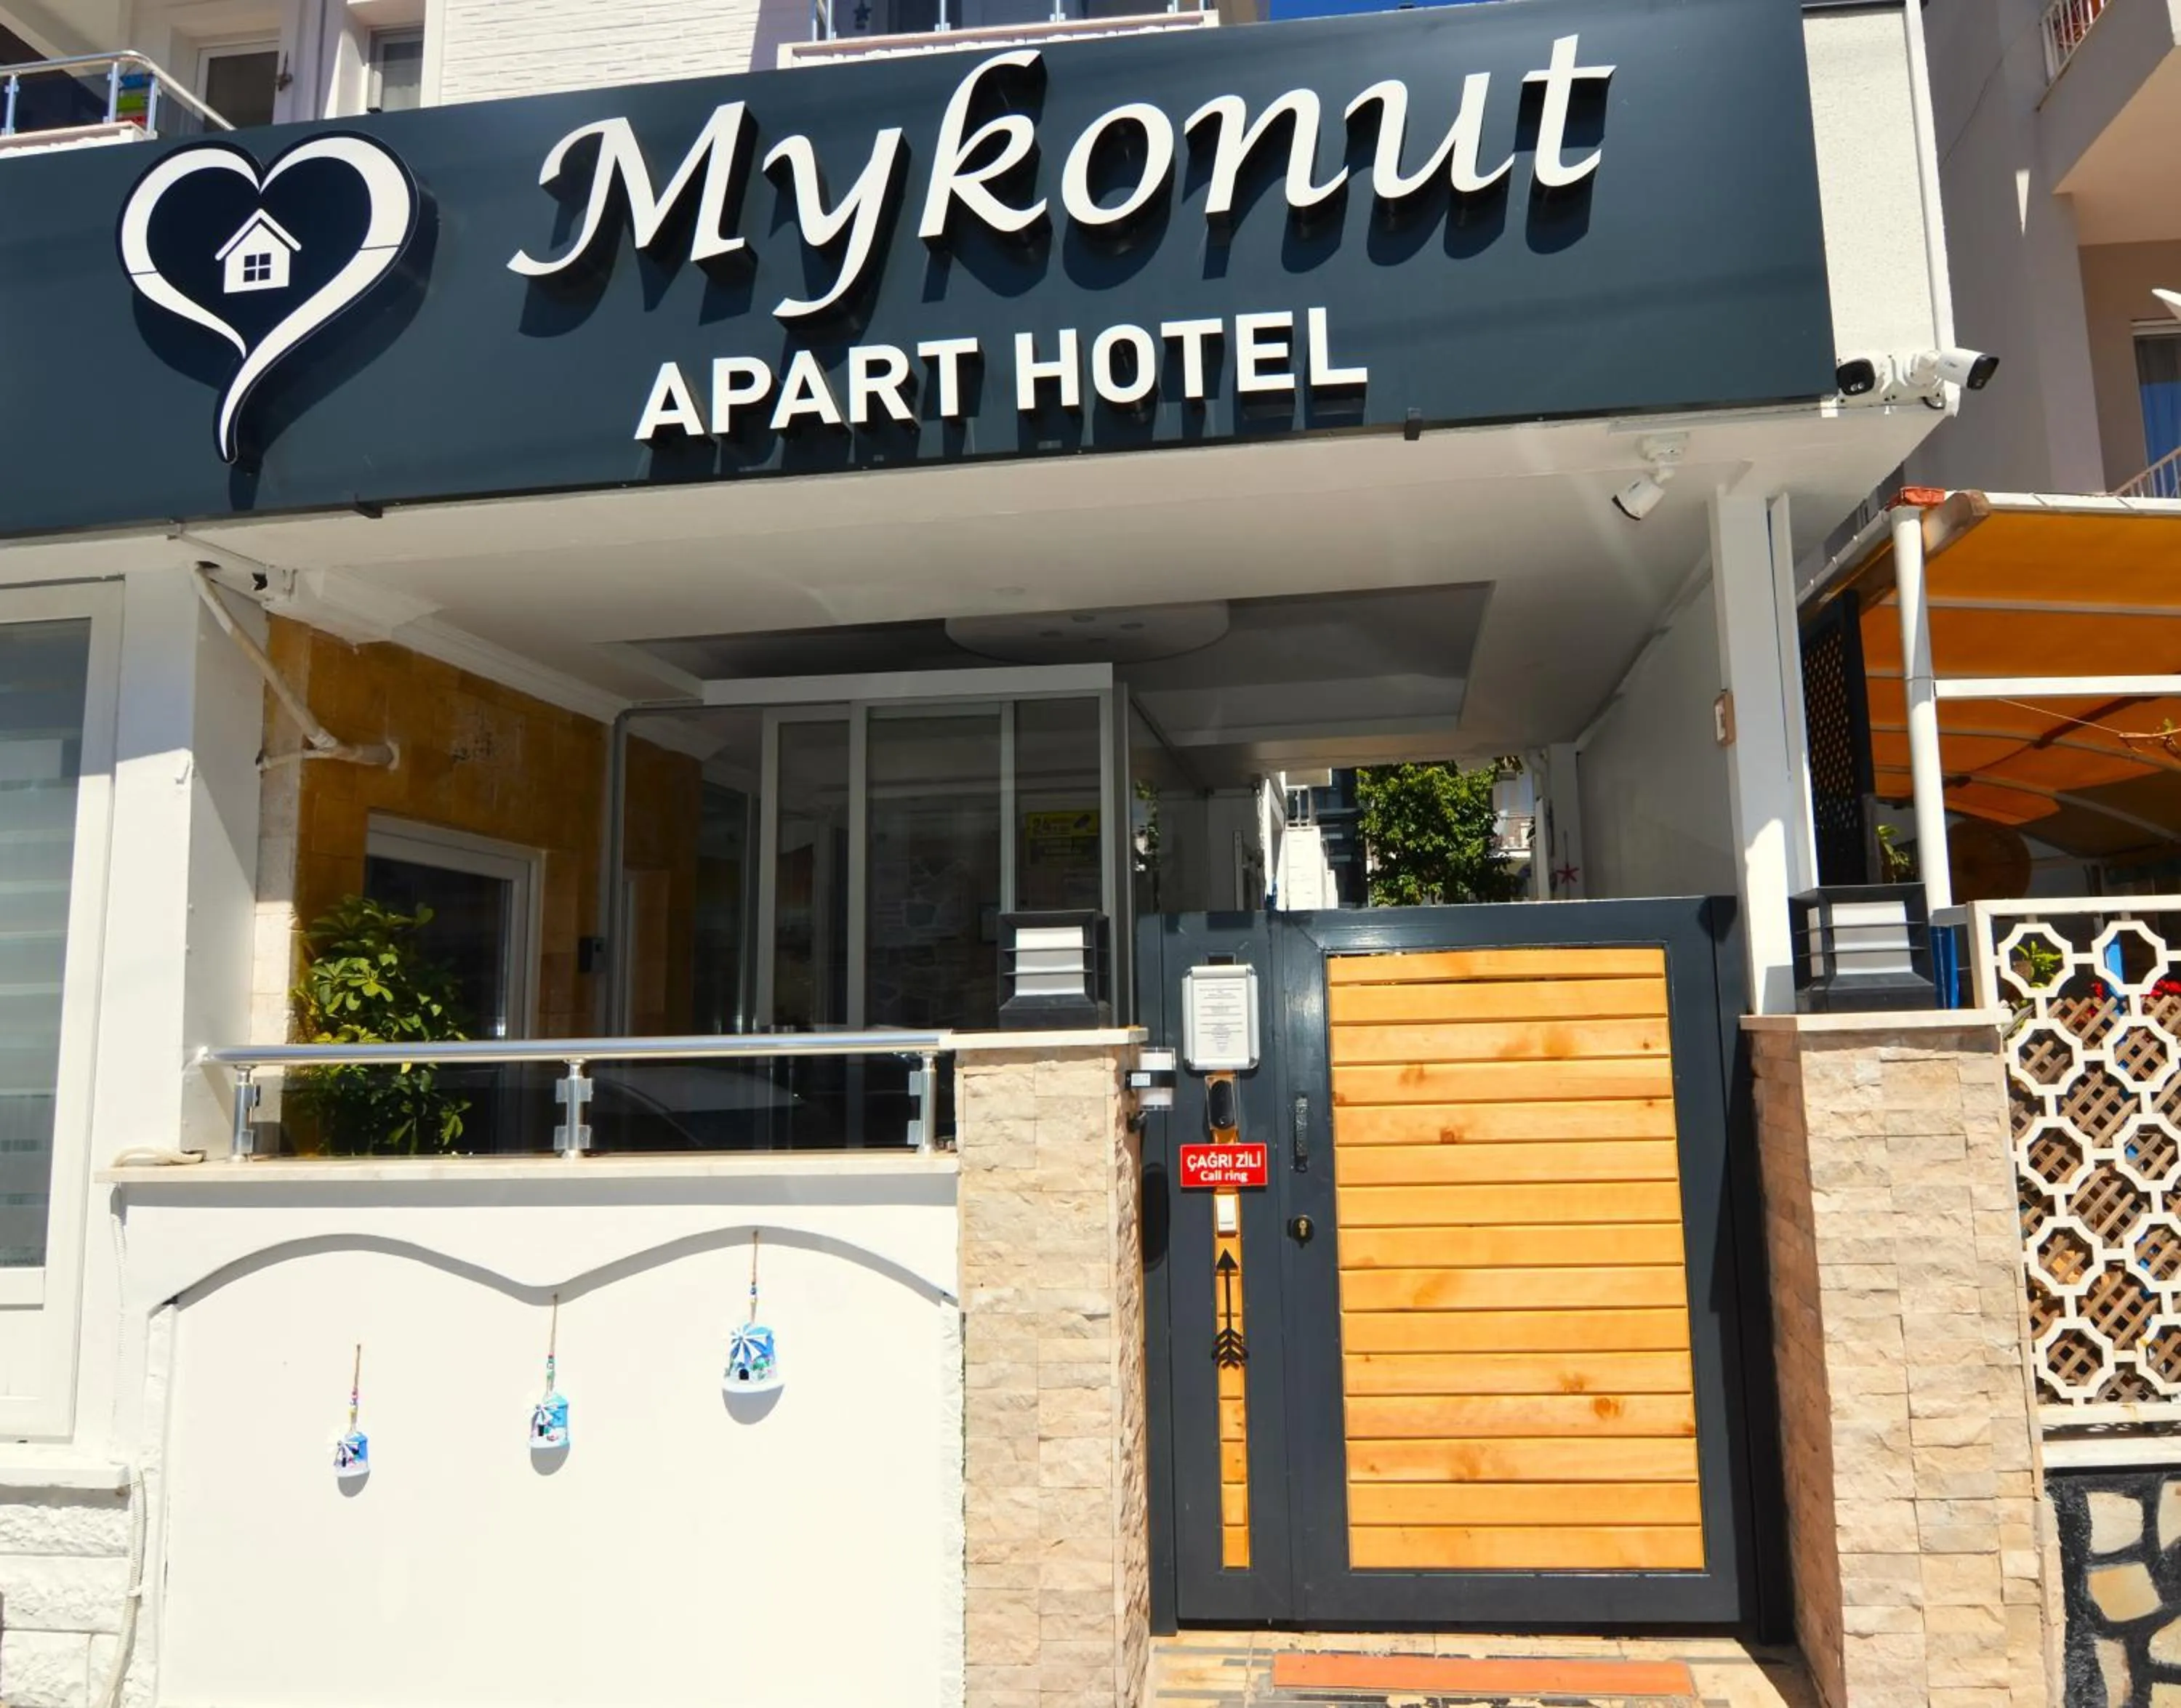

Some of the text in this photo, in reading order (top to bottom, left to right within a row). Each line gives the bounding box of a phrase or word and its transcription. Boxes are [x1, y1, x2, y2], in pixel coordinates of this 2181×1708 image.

[507, 35, 1616, 318] Mykonut
[635, 307, 1367, 440] APART HOTEL
[1186, 1151, 1261, 1172] ÇAĞRI ZİLİ
[1200, 1169, 1248, 1183] Call ring
